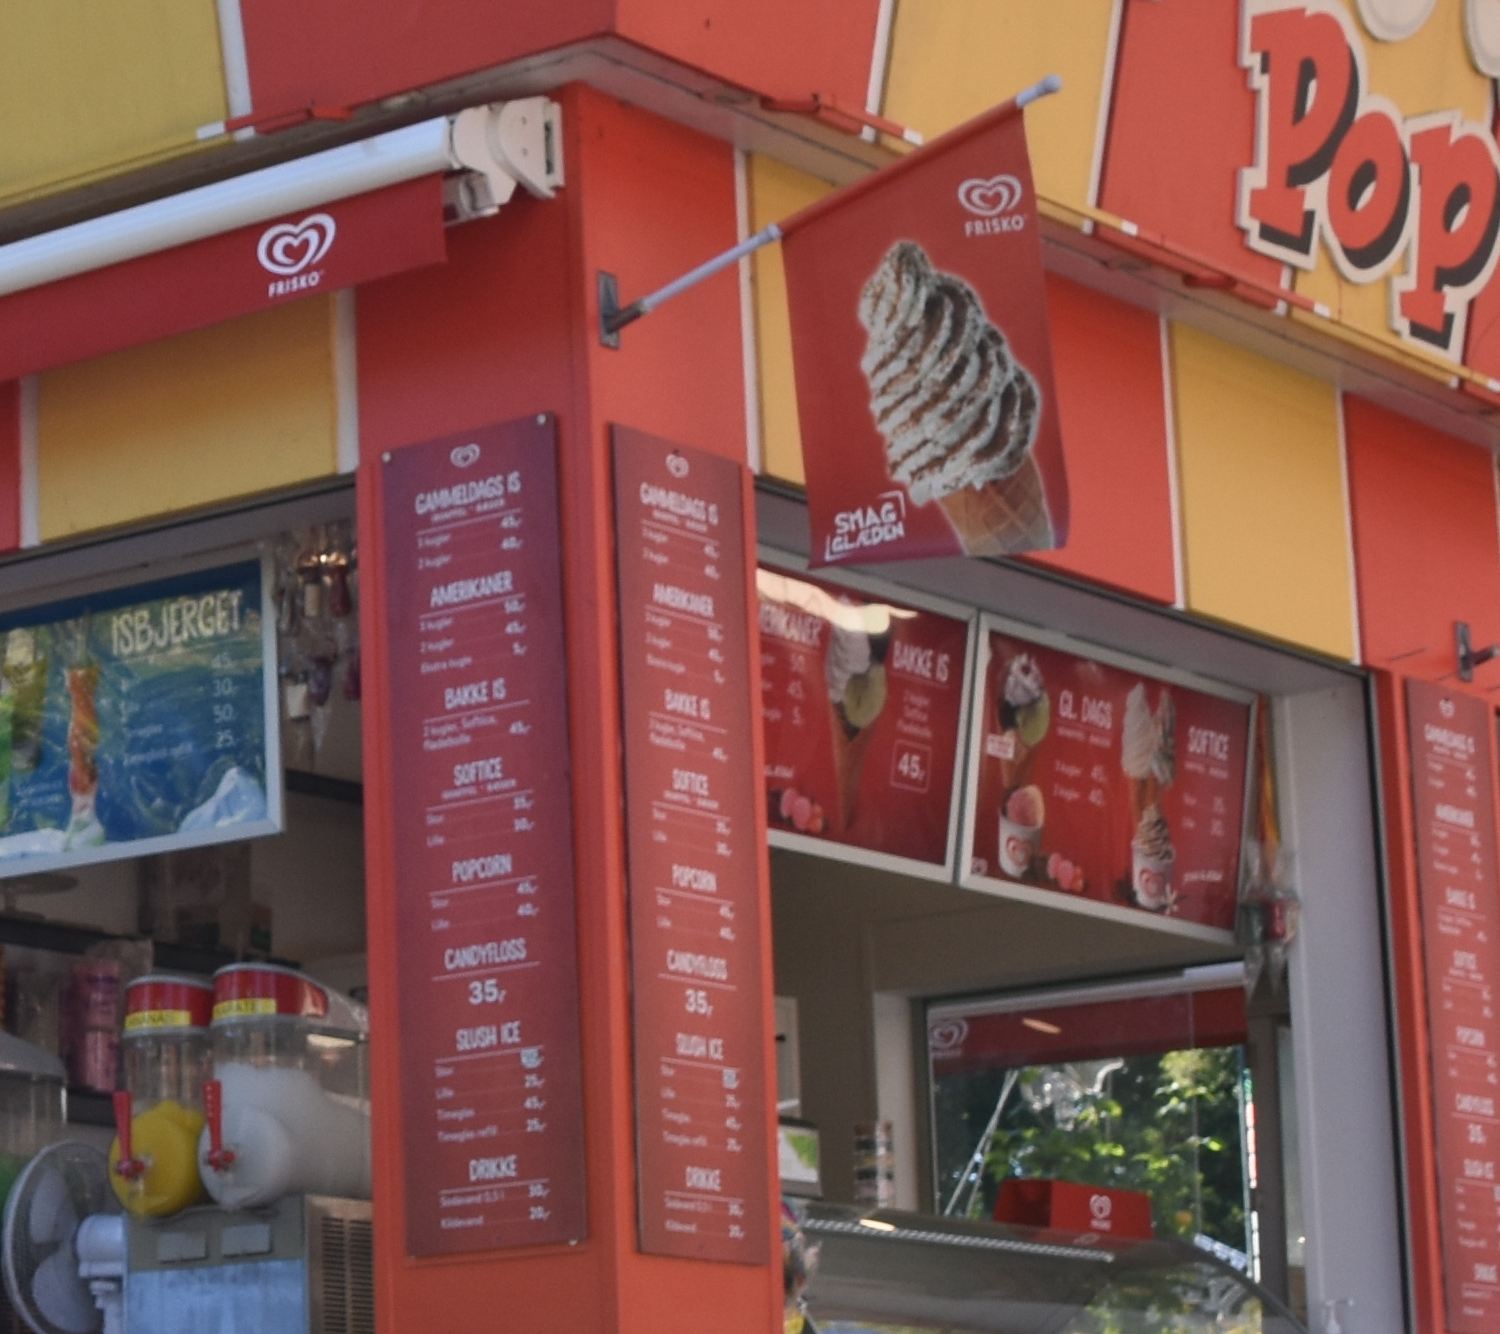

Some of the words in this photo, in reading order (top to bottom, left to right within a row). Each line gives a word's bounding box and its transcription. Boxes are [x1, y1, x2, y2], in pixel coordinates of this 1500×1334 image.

[965, 215, 1025, 236] FRISKO
[268, 271, 320, 297] FRISKO
[507, 471, 521, 493] IS
[834, 502, 897, 534] SMAG
[832, 521, 904, 552] GLÆDEN
[430, 570, 513, 608] AMERIKANER
[112, 590, 243, 656] ISBJERGET
[892, 639, 932, 679] BAKKE
[936, 652, 948, 682] IS
[444, 680, 488, 710] BAKKE
[492, 677, 506, 699] IS
[454, 757, 502, 786] SOFTICE
[452, 854, 513, 882] POPCORN
[444, 938, 527, 970] CANDYFLOSS
[456, 1026, 497, 1051] SLUSH
[501, 1020, 521, 1044] ICE
[469, 1155, 517, 1181] DRIKKE
